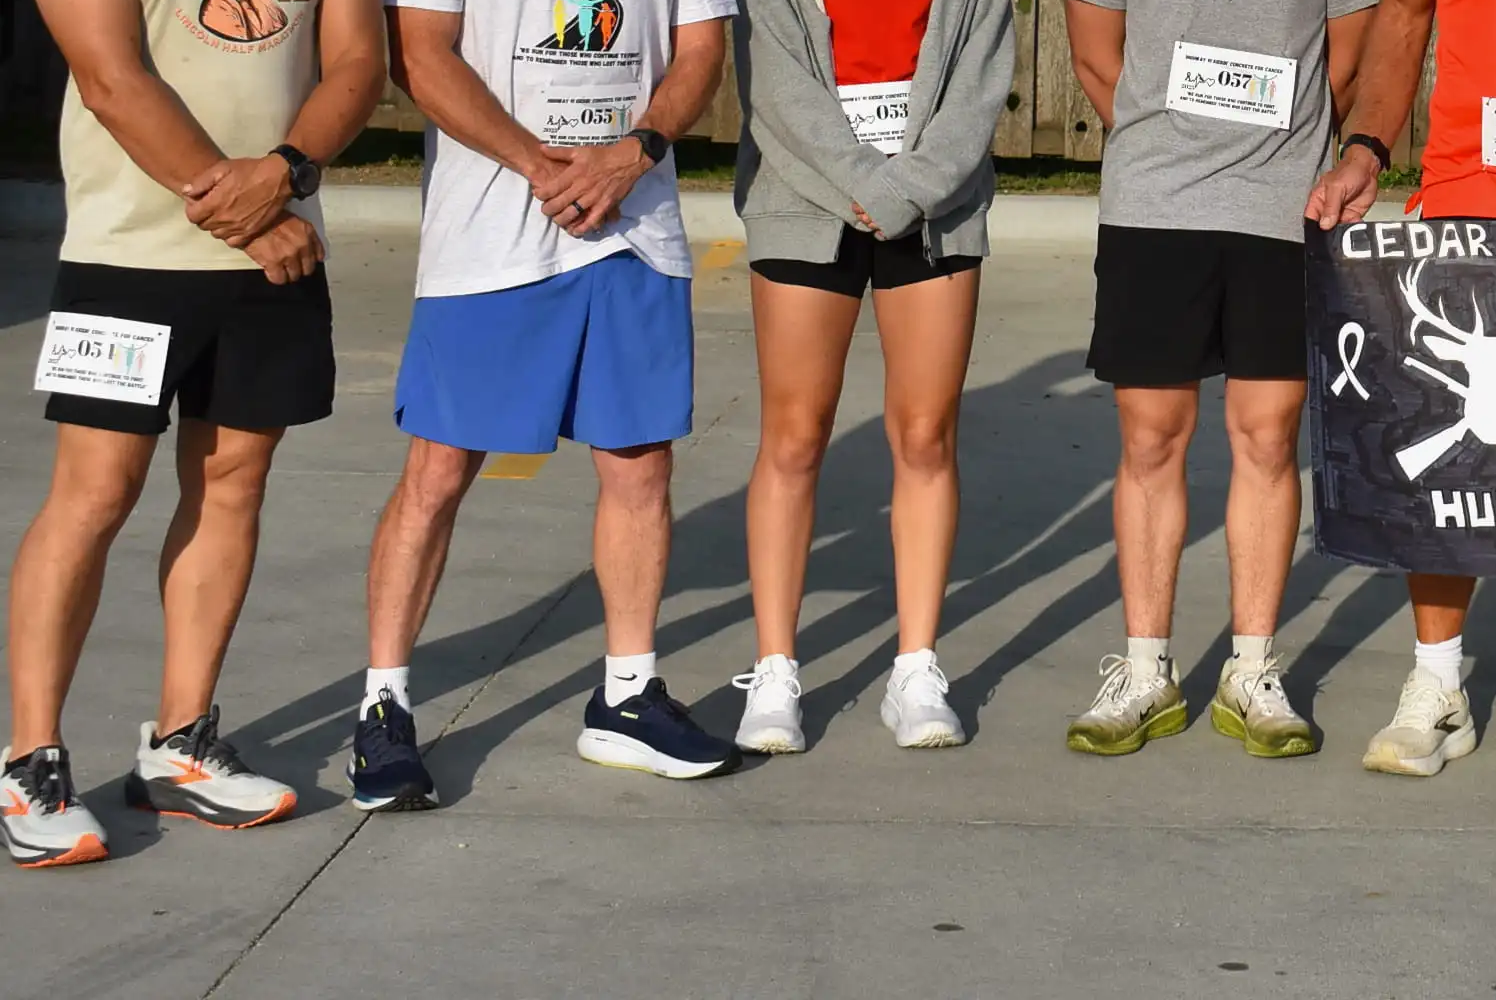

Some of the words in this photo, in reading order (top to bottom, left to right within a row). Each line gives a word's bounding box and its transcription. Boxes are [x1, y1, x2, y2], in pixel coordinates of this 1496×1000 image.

[223, 43, 254, 53] HALF
[1218, 71, 1252, 89] 057
[581, 108, 612, 124] 055
[877, 103, 908, 120] 053
[1342, 222, 1493, 258] CEDAR
